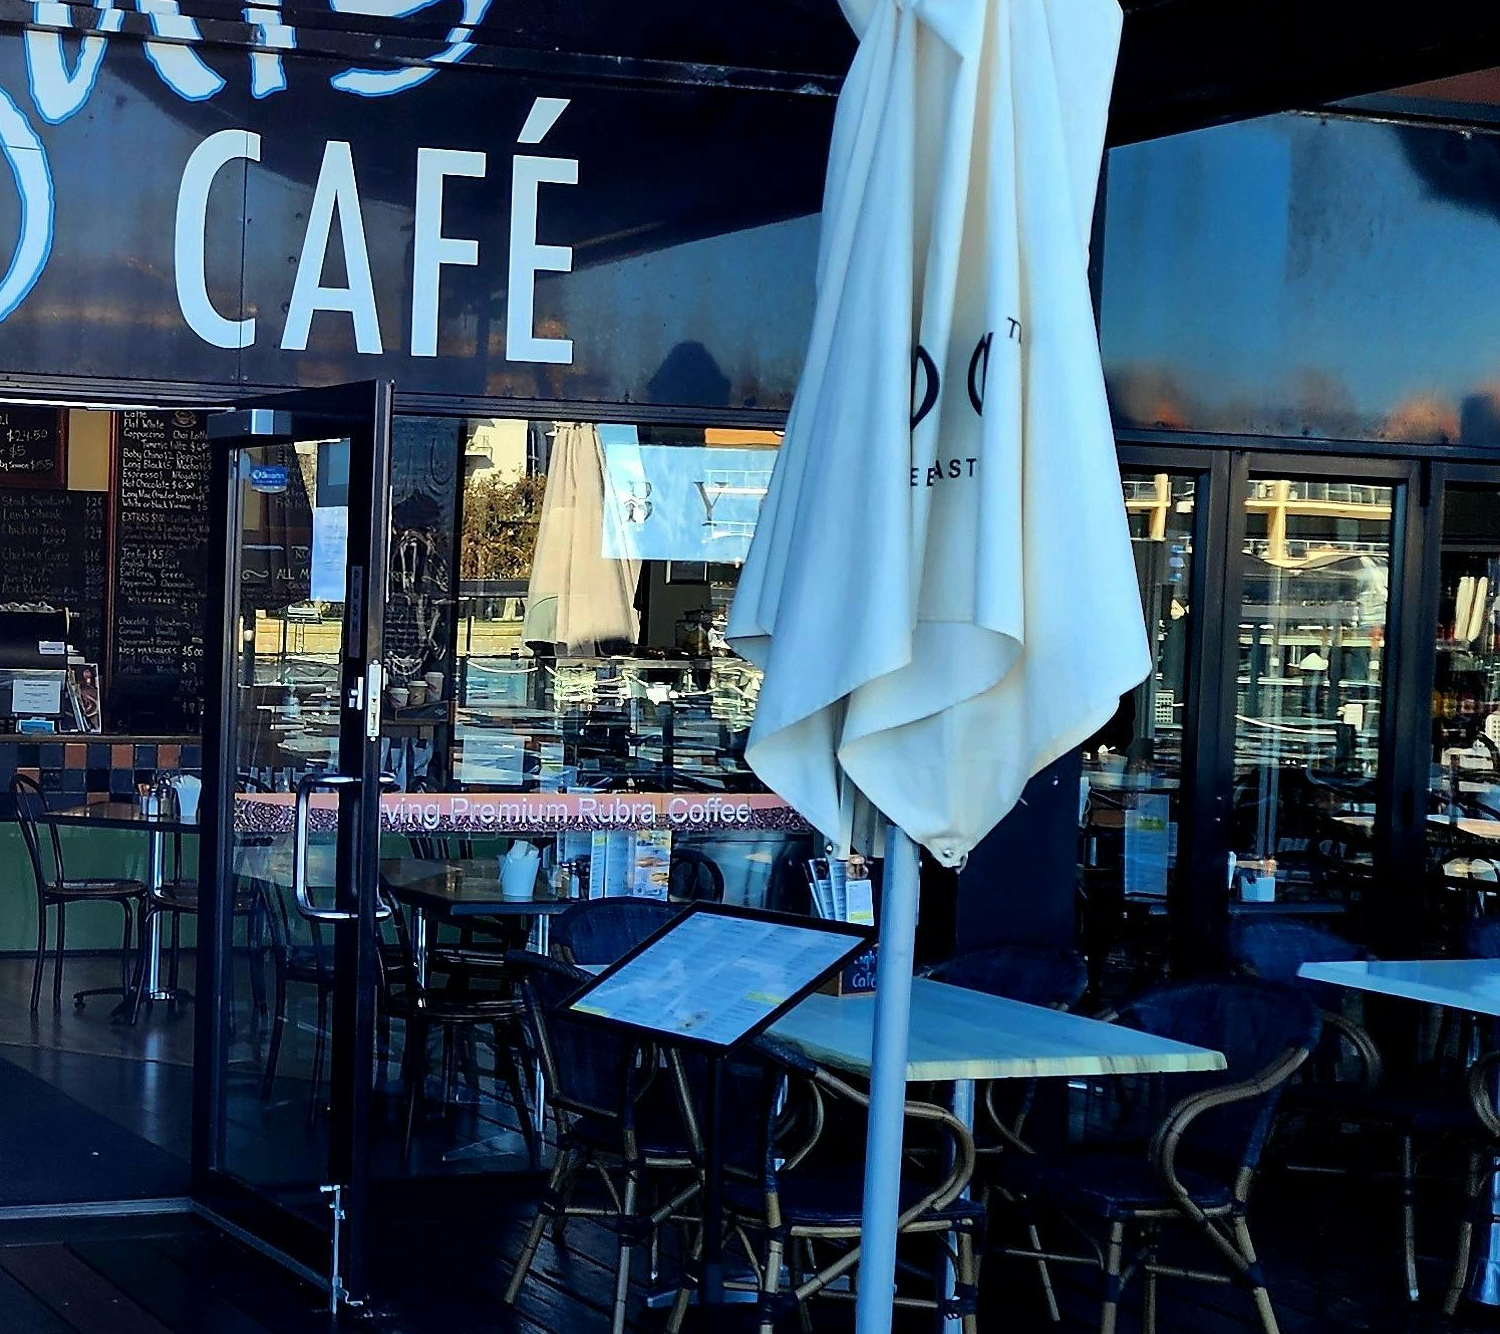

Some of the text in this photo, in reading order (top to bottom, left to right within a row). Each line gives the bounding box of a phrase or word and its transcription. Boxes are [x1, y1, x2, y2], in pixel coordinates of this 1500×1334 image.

[174, 97, 580, 365] CAFÉ
[450, 798, 569, 823] Premium
[578, 798, 656, 823] Rubra
[668, 798, 753, 823] Coffee
